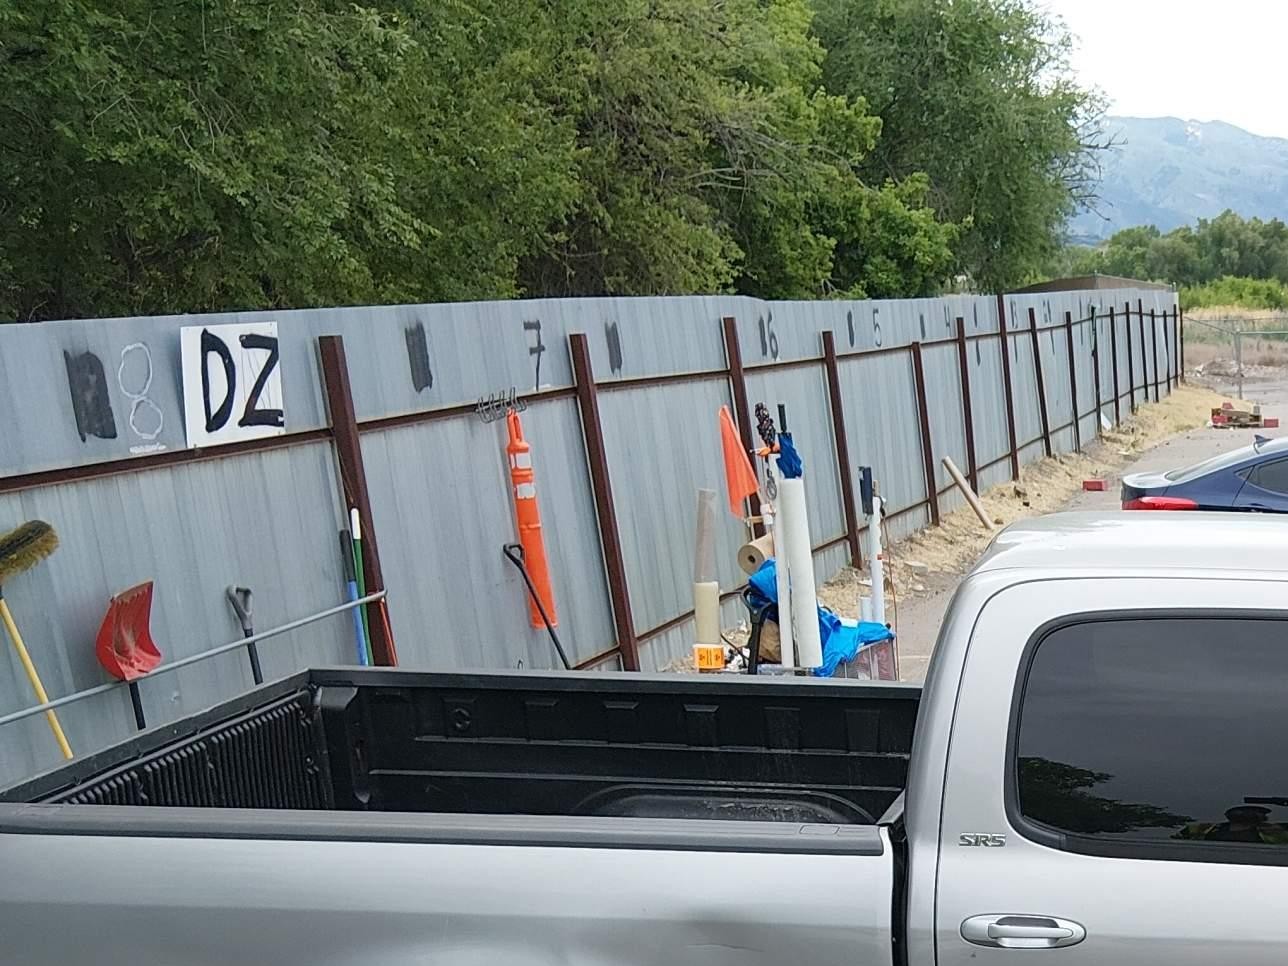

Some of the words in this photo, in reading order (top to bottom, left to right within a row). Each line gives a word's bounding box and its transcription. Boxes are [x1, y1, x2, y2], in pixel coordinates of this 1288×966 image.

[118, 342, 163, 439] 8
[200, 328, 284, 433] DZ
[523, 320, 545, 391] 7
[959, 833, 1006, 847] SR5
